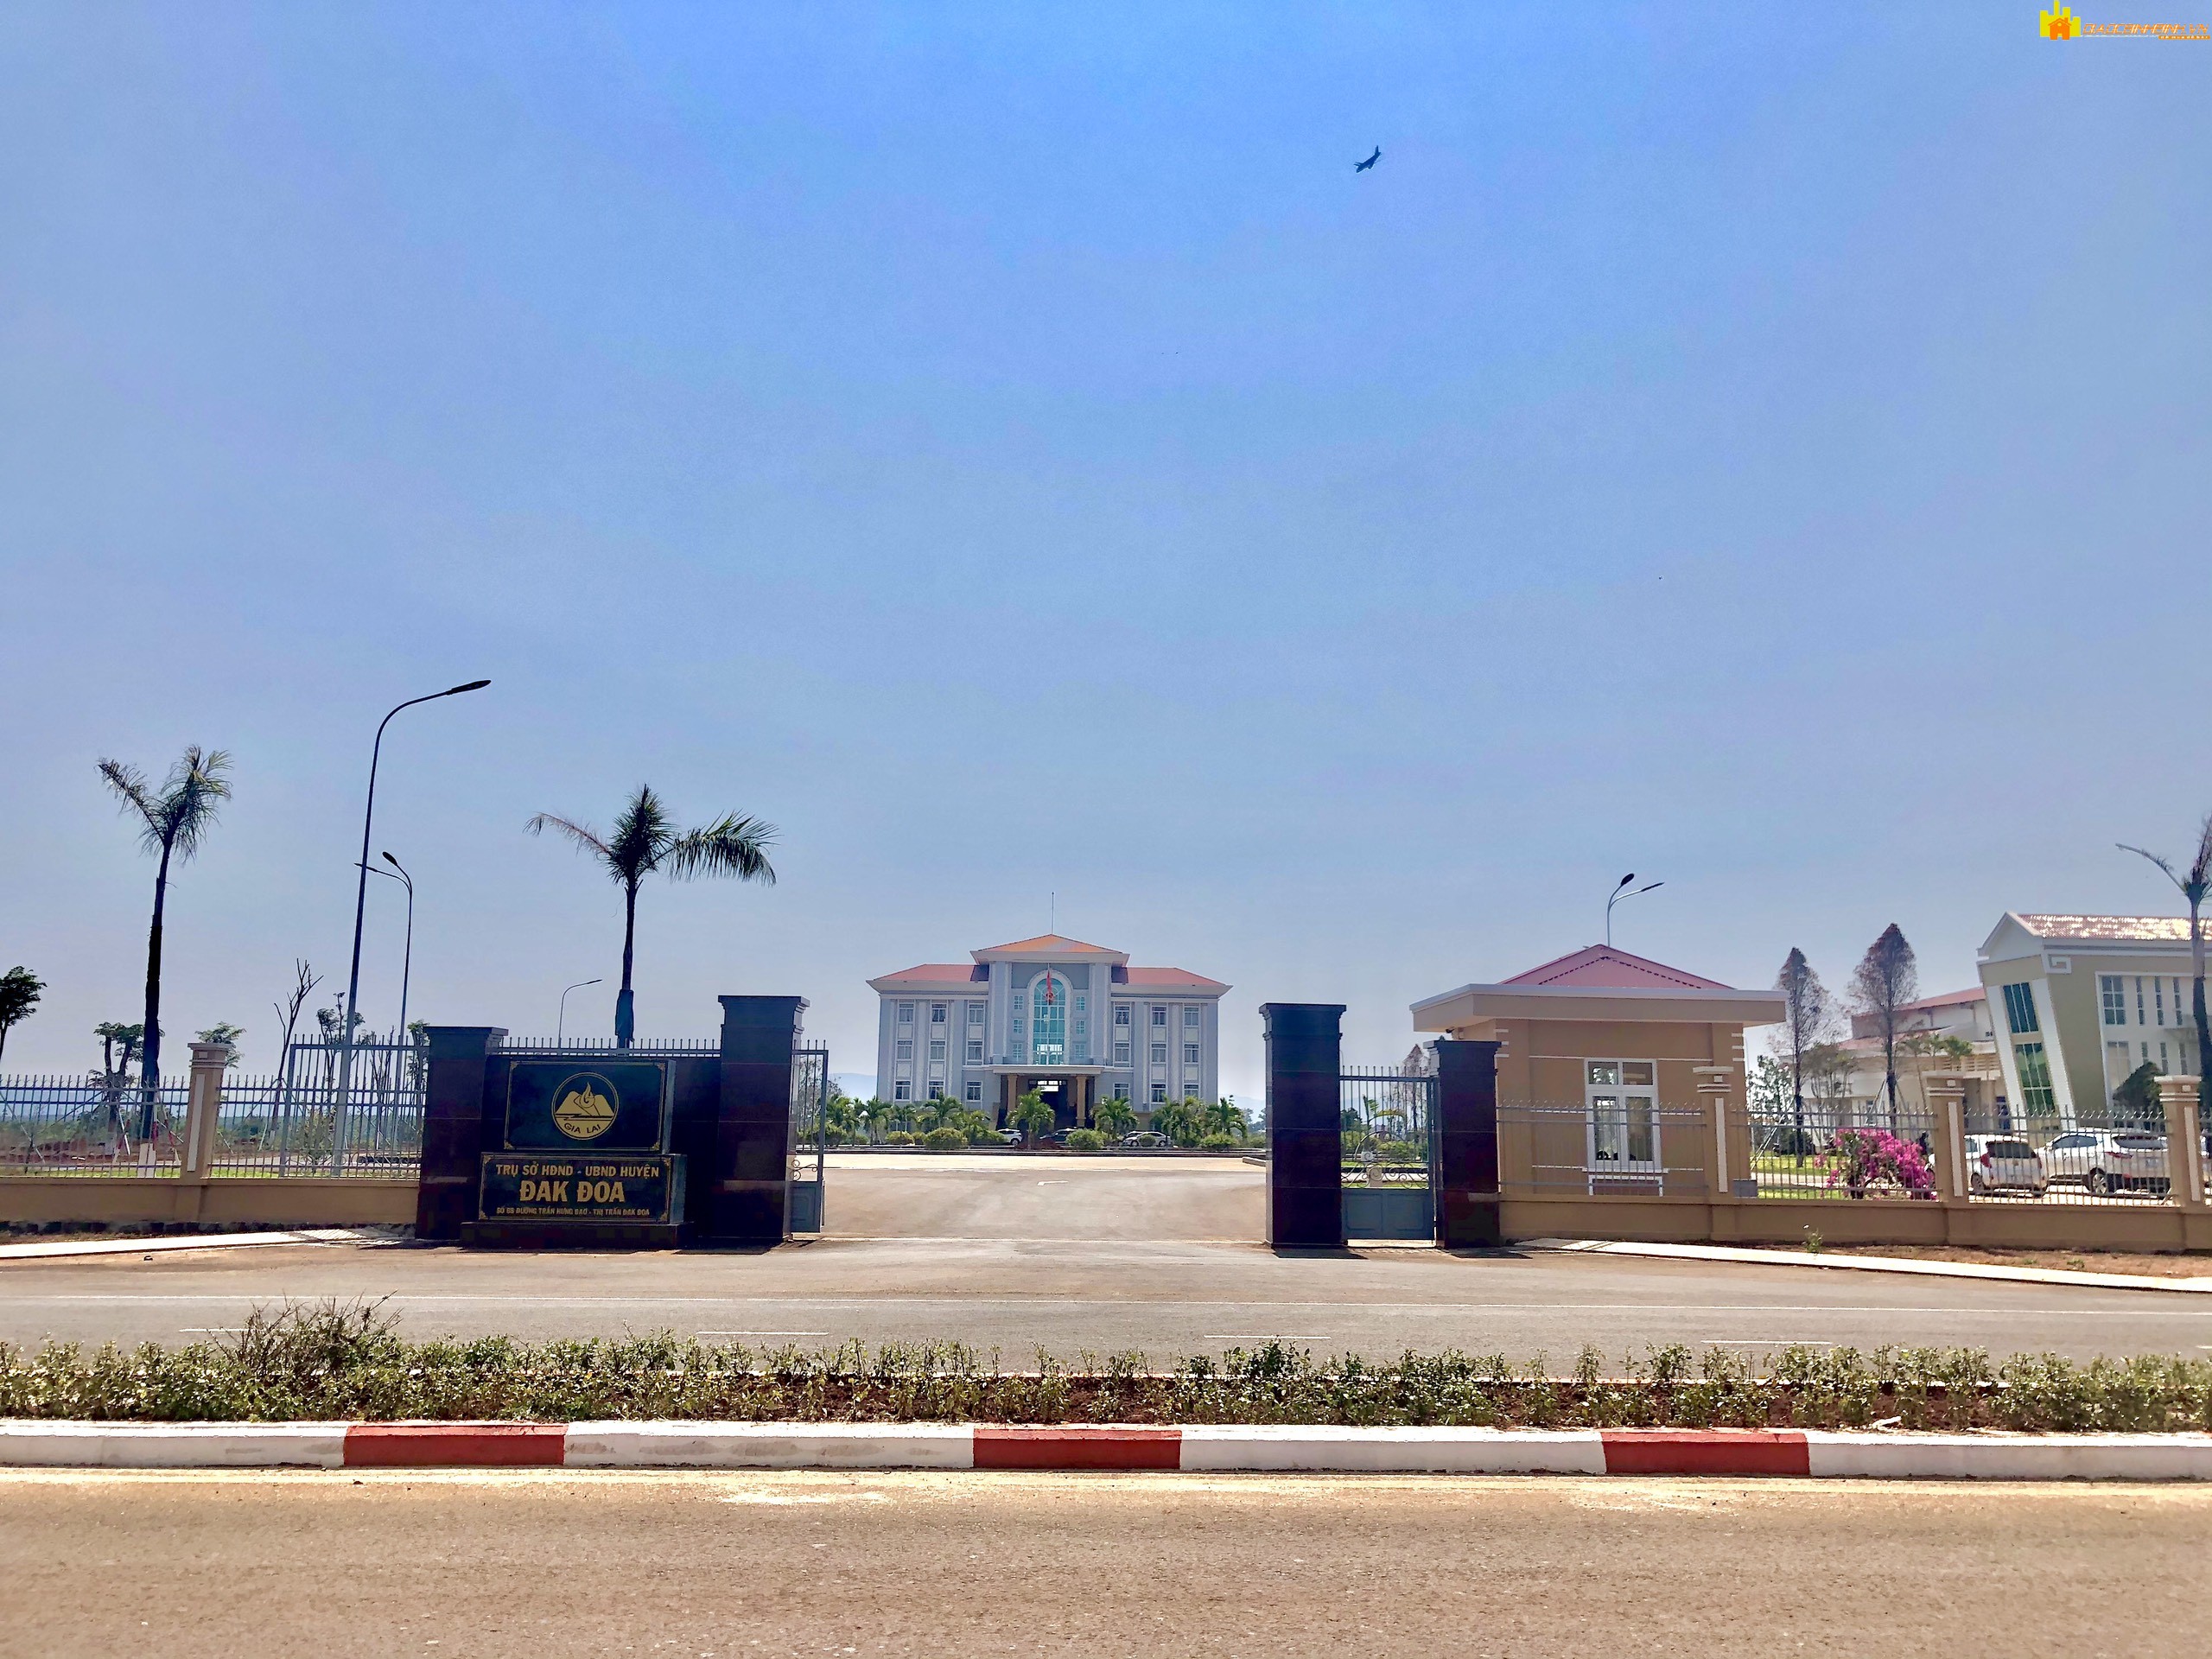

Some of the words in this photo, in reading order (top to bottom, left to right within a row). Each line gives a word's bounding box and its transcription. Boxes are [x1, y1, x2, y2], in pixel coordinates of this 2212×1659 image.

[564, 1122, 581, 1134] GIA
[586, 1124, 601, 1134] LAI
[496, 1164, 518, 1178] TRỤ
[522, 1161, 539, 1176] SỞ
[542, 1165, 574, 1176] HĐND
[585, 1166, 616, 1177] UBND
[620, 1163, 659, 1179] HUYỆN
[519, 1179, 569, 1202] ĐAK
[576, 1180, 626, 1202] ĐOA
